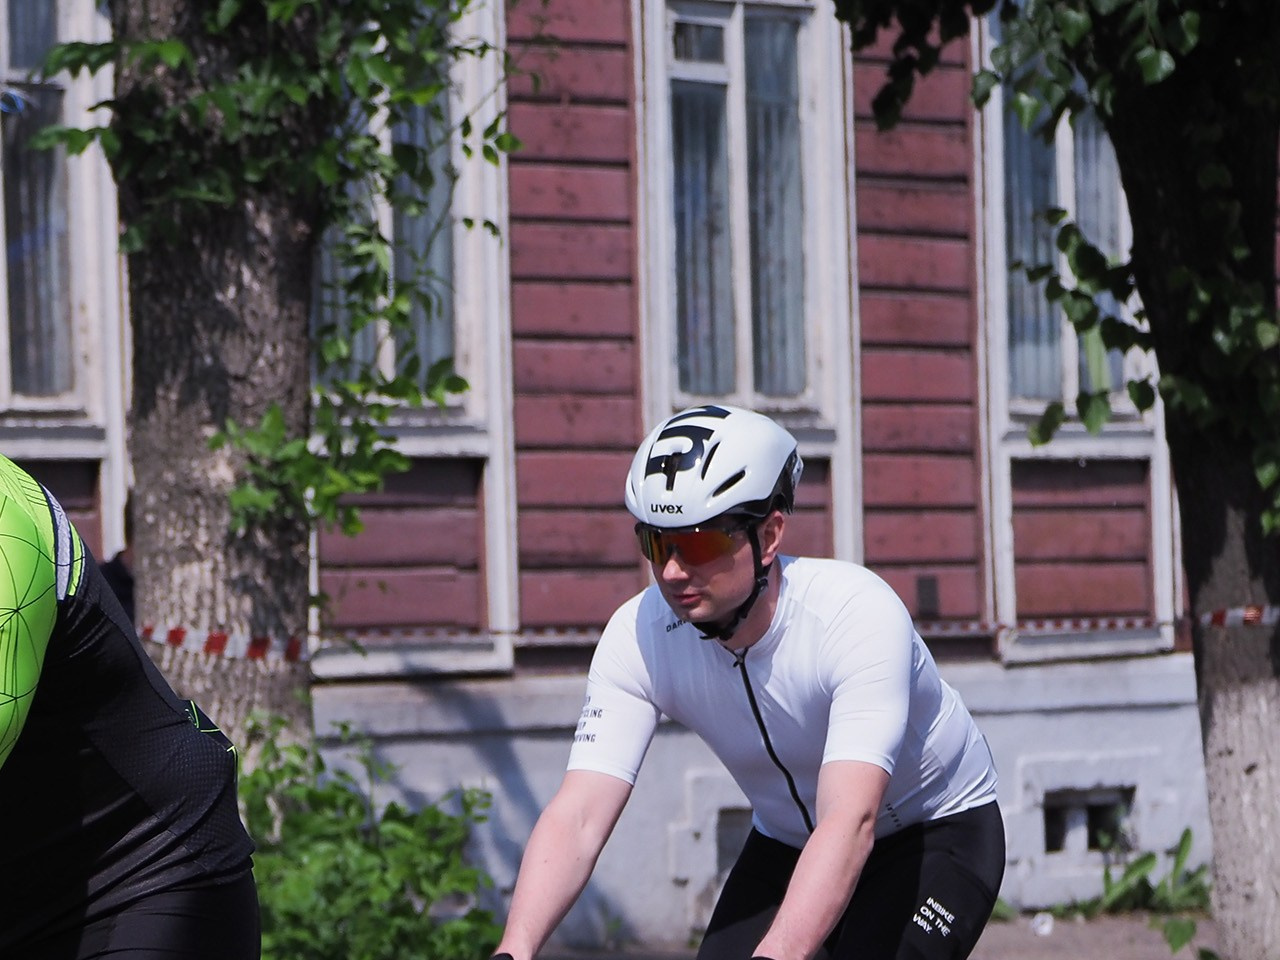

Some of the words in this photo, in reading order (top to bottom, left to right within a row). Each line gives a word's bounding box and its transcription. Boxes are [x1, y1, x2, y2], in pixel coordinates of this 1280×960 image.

[650, 503, 684, 514] uvex
[920, 905, 935, 921] ON
[934, 917, 952, 937] THE
[926, 896, 956, 924] INBIKE
